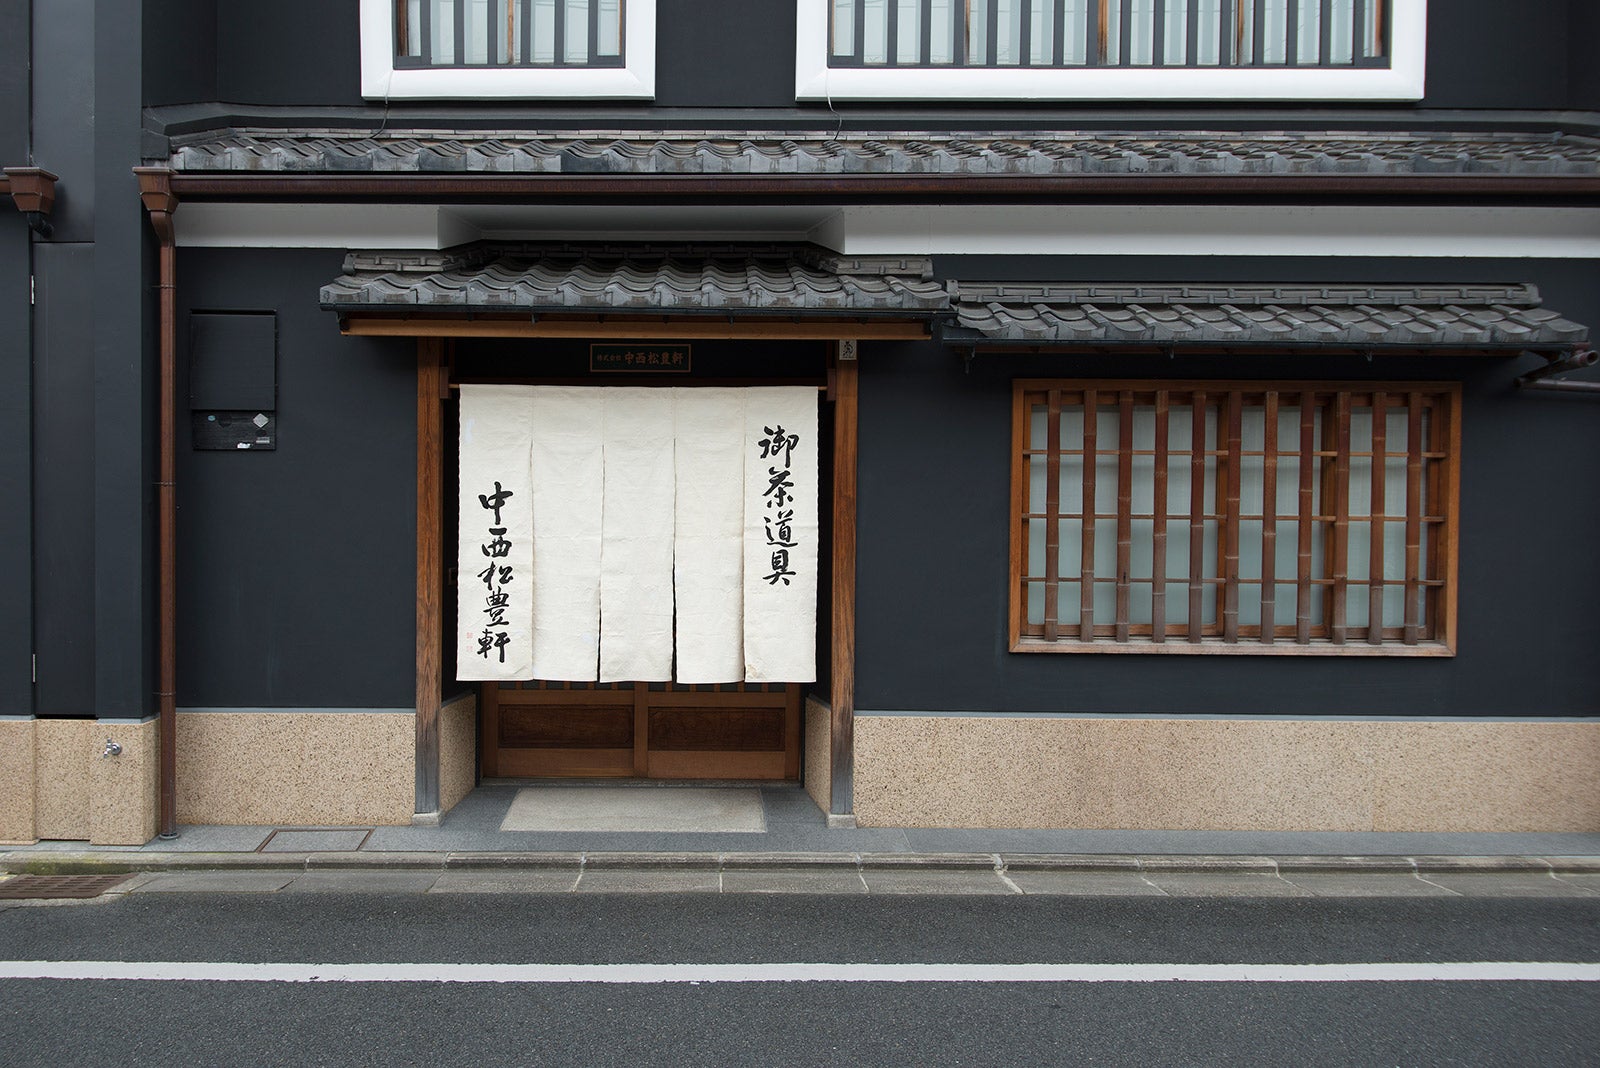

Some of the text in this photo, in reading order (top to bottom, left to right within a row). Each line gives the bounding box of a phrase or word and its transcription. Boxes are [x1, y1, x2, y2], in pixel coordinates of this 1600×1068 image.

[476, 481, 514, 663] 中西松豊軒
[758, 425, 799, 586] 御茶道具
